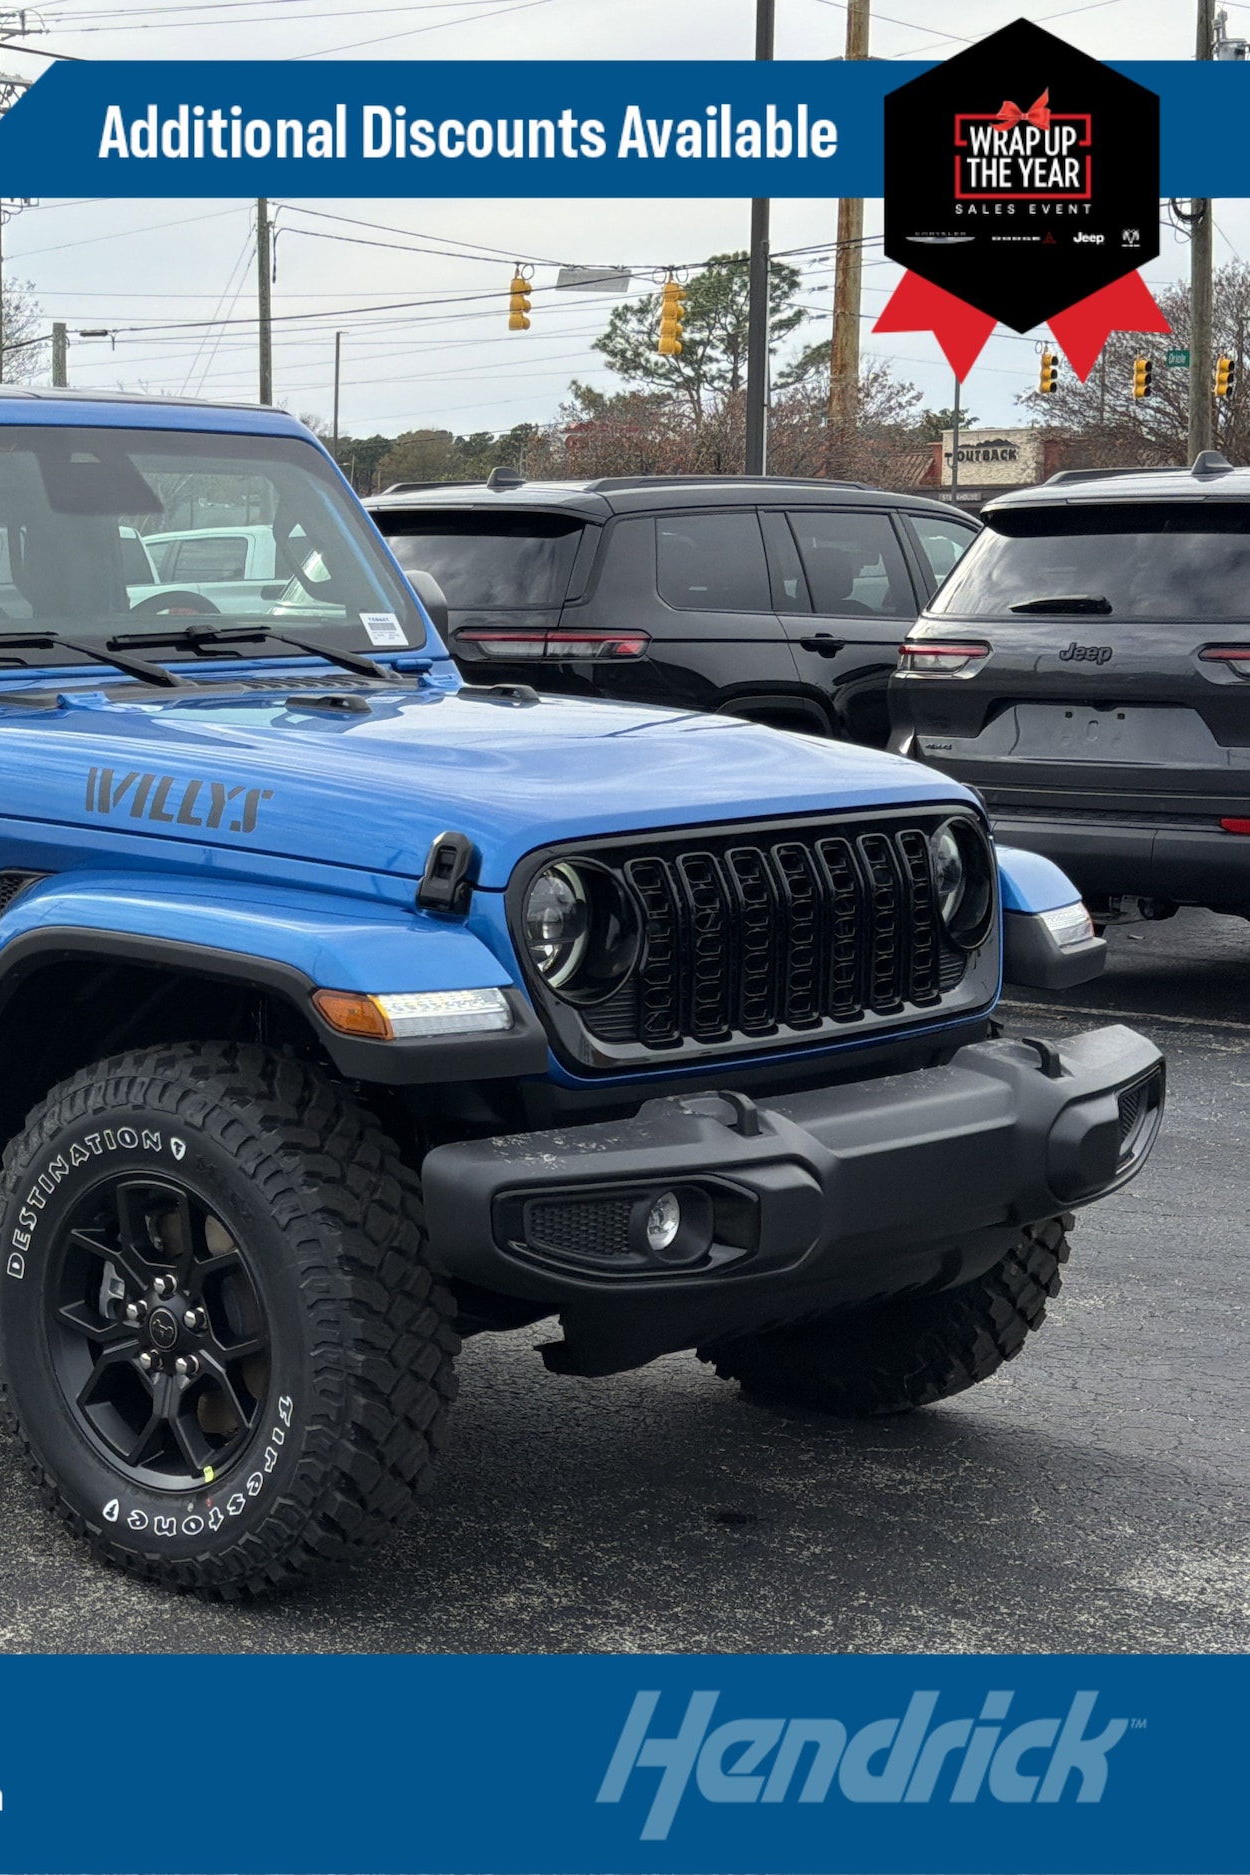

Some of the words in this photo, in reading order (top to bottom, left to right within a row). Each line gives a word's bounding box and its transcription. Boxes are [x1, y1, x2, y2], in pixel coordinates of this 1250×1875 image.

[957, 448, 1019, 463] OUTBACK
[1059, 642, 1113, 666] Jeep
[85, 766, 275, 834] WILLYS
[7, 1125, 163, 1280] DESTINATION
